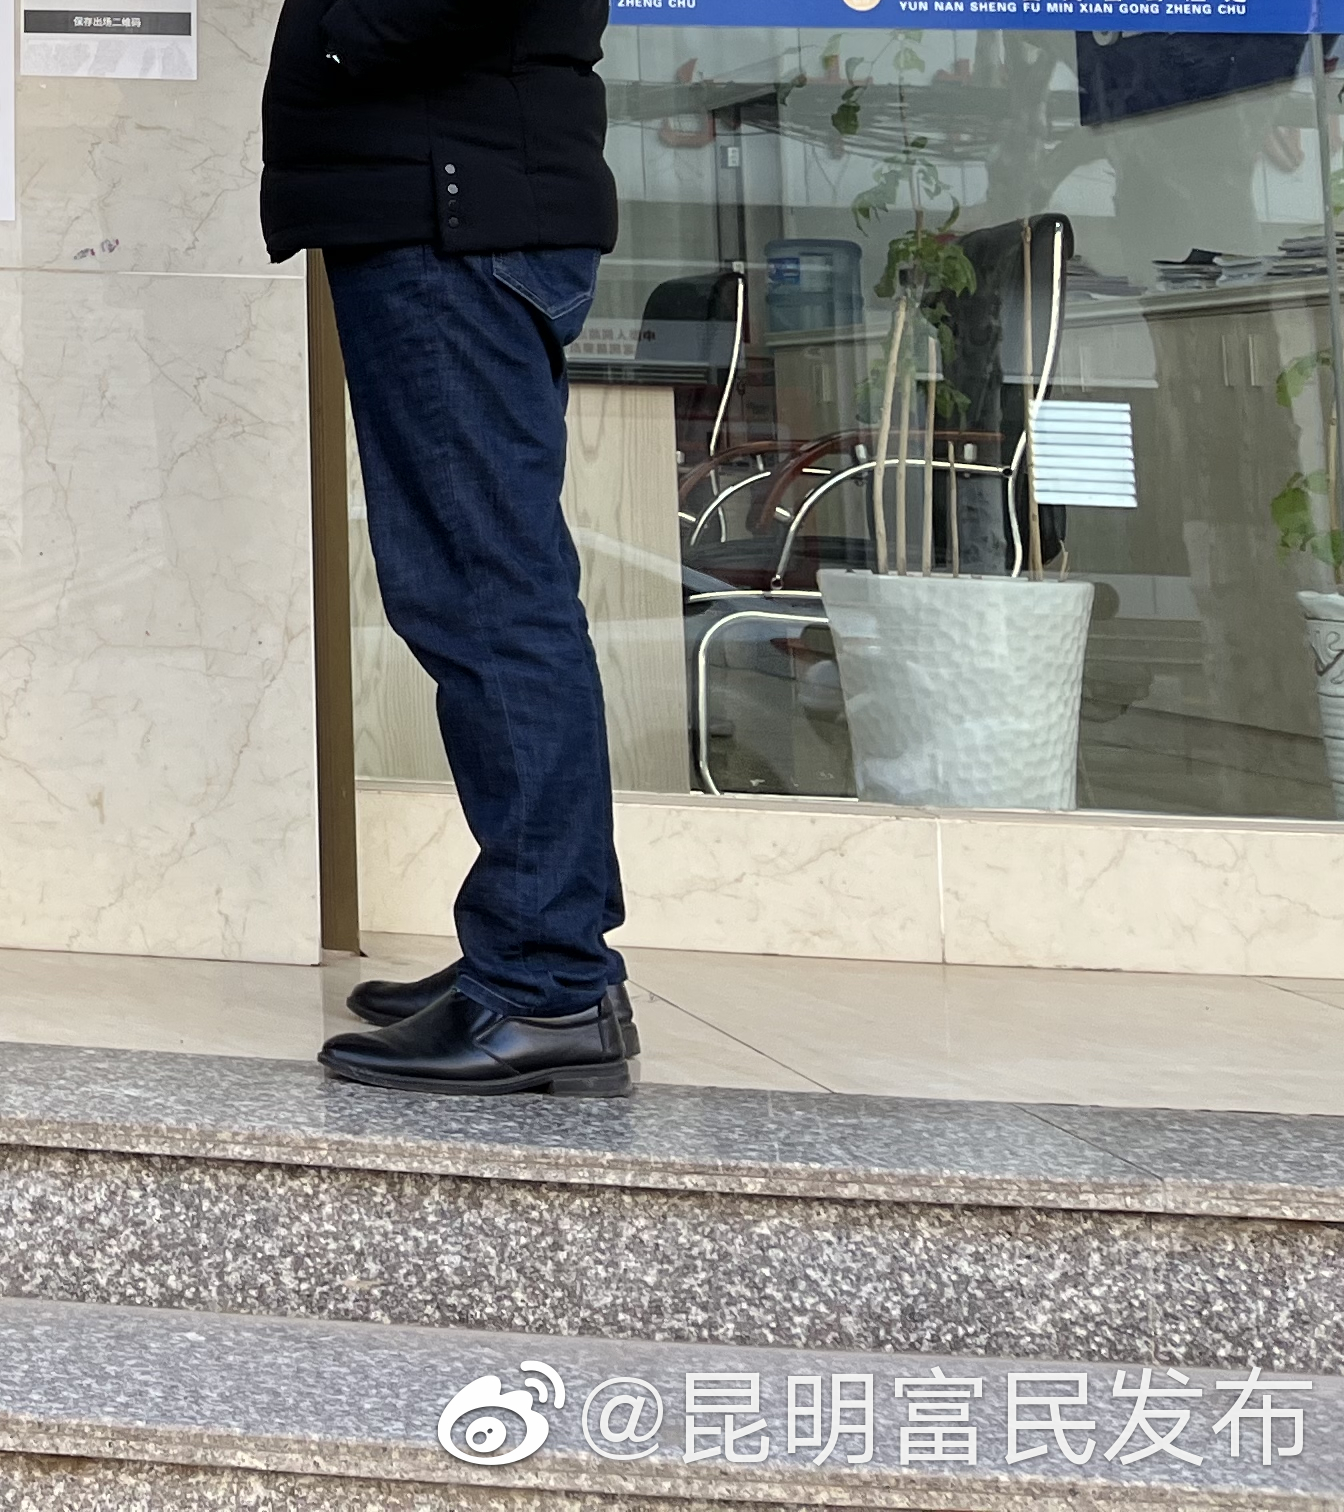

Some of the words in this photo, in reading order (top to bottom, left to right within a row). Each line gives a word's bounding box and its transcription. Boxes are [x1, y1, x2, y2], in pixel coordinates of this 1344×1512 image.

[899, 1, 928, 11] YUN
[934, 2, 964, 12] NAN
[970, 2, 1017, 12] SHENG
[1023, 2, 1041, 13] FU
[1046, 3, 1074, 13] MIN
[1079, 3, 1113, 13] XIAN
[1119, 3, 1160, 14] GONG
[1166, 4, 1212, 15] ZHENG
[1217, 4, 1247, 15] CHU
